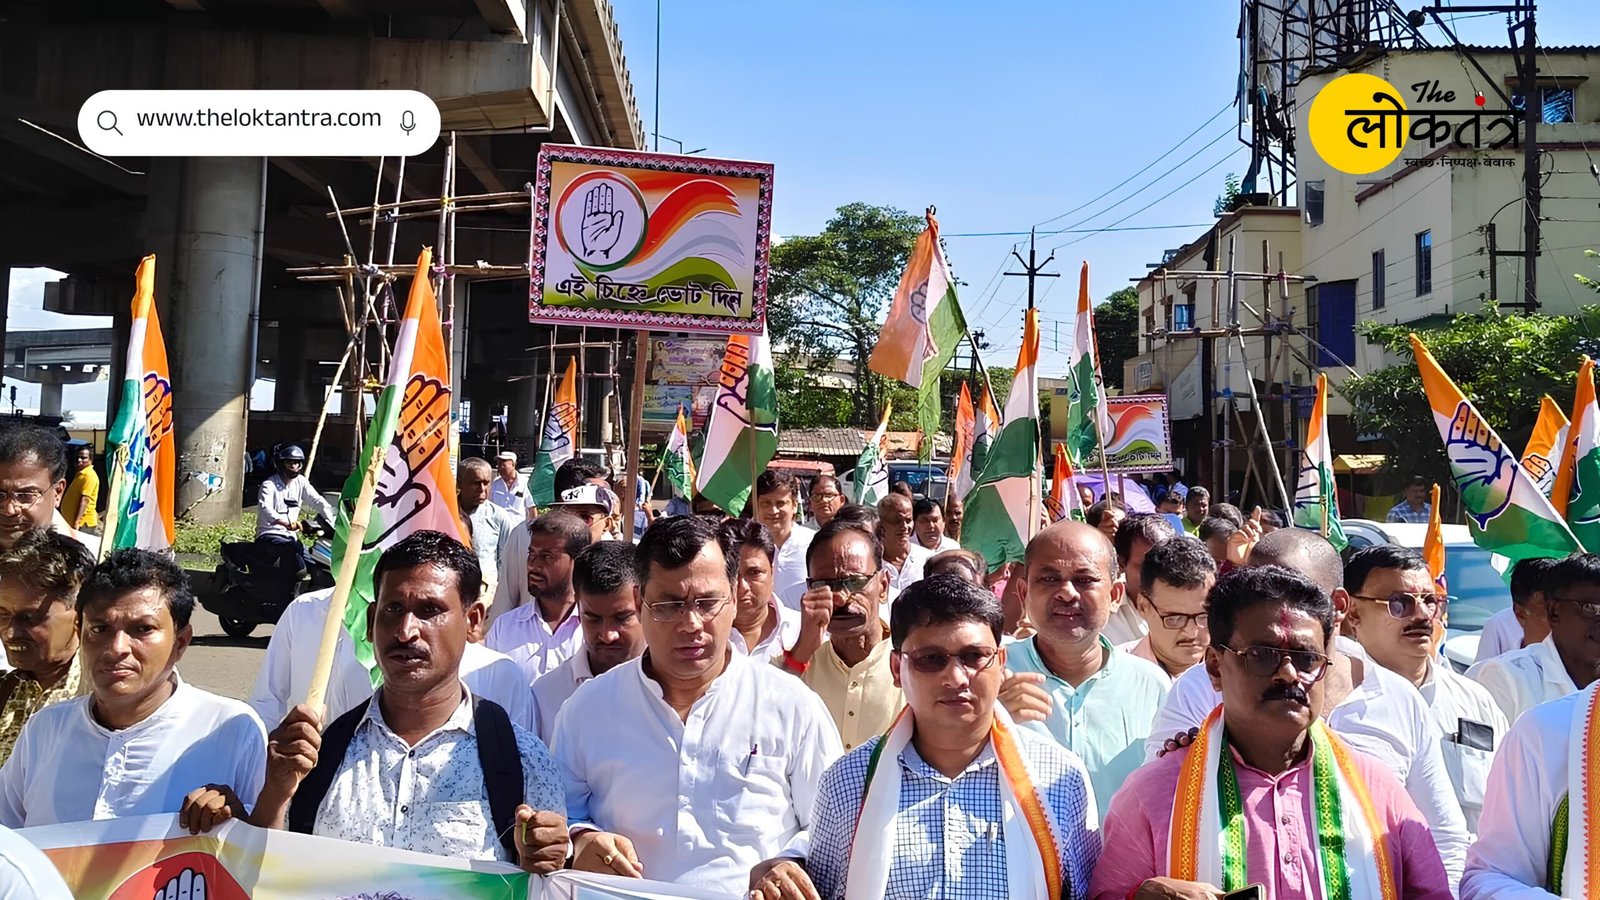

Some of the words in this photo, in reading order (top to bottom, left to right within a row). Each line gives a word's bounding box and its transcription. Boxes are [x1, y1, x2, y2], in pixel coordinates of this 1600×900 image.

[555, 273, 588, 300] এই
[656, 281, 703, 304] ভোট
[709, 283, 743, 315] দিন
